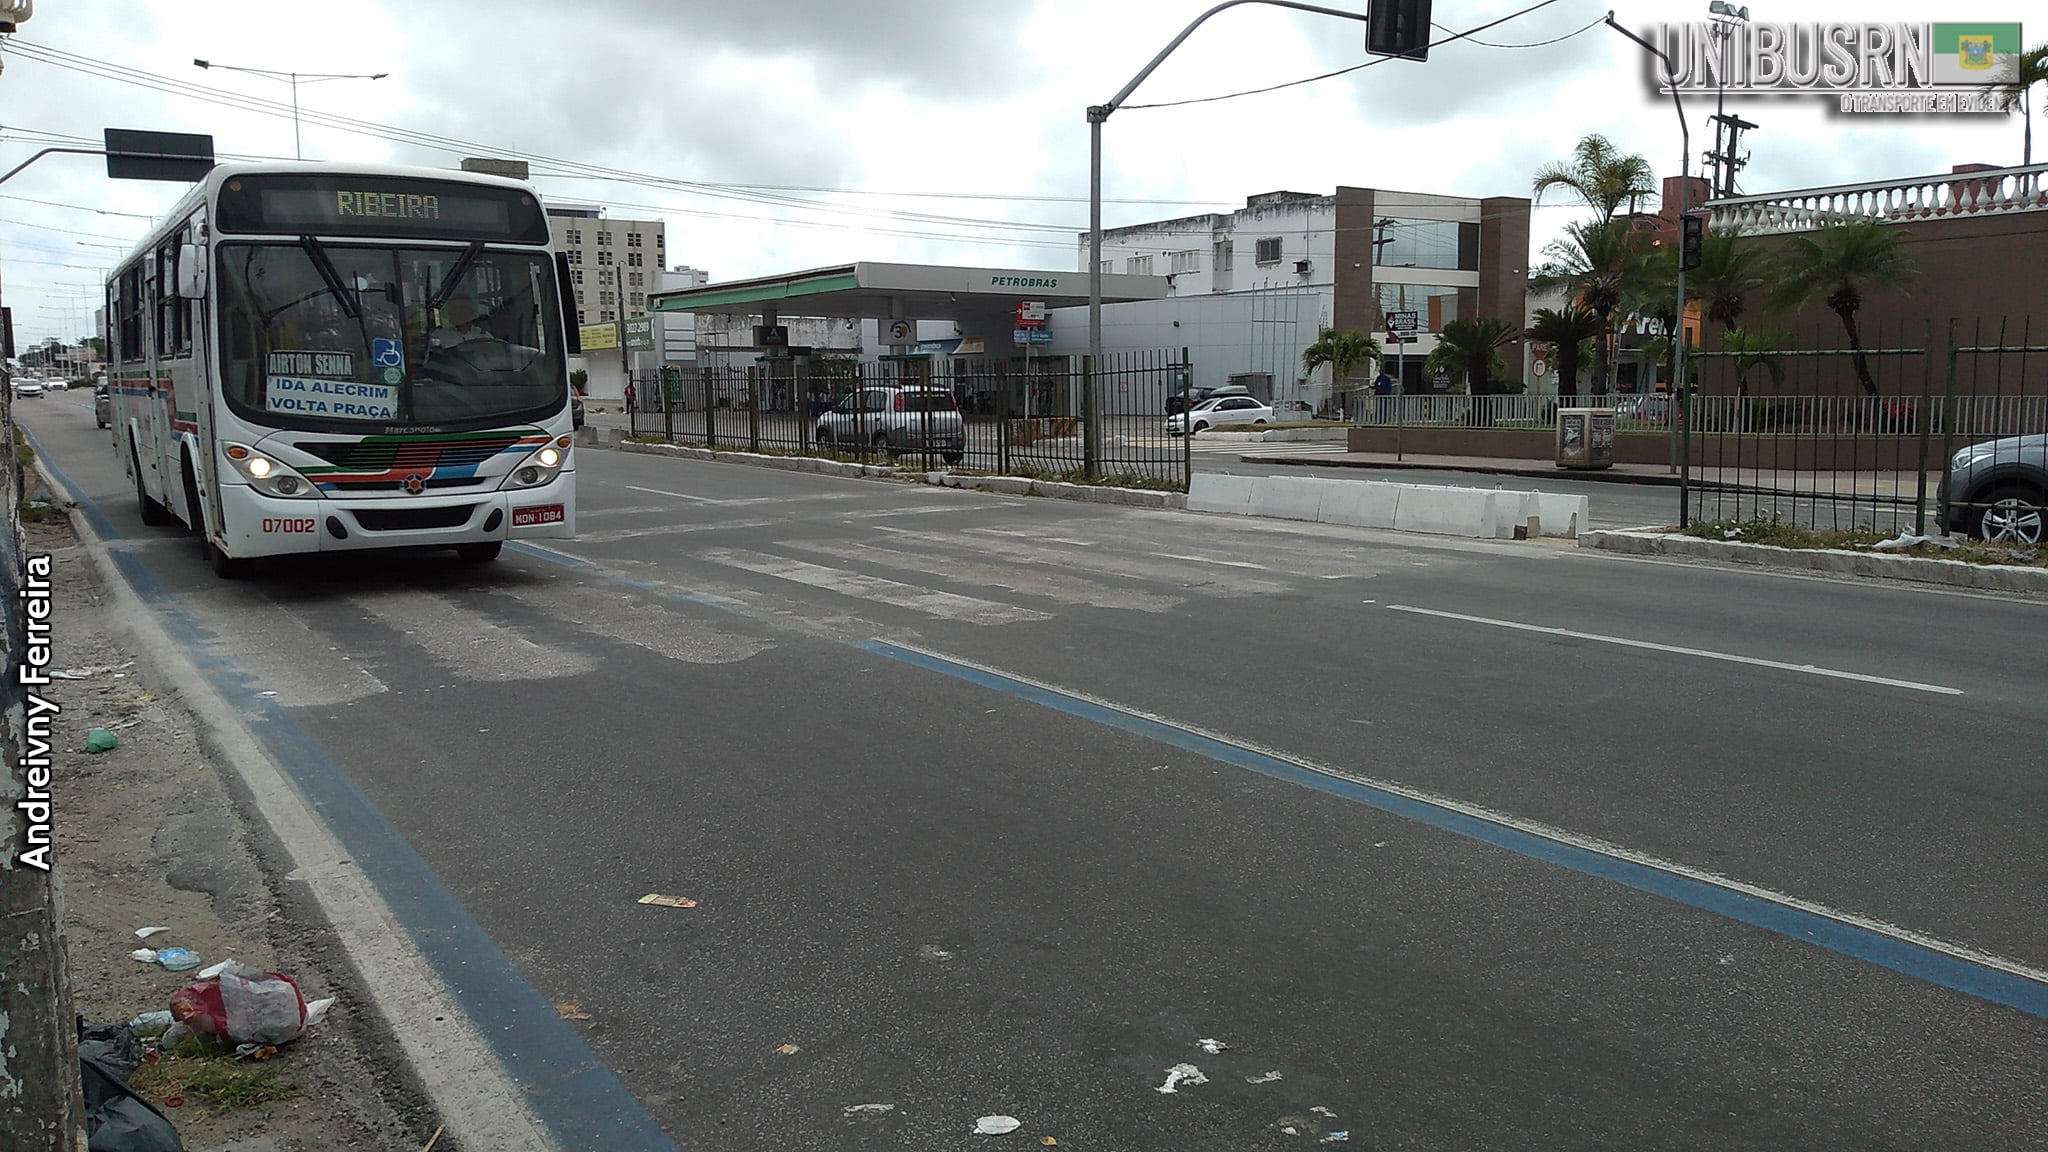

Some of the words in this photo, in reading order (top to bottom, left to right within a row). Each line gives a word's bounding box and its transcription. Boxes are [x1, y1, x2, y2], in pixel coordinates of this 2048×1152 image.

[337, 191, 439, 219] RIBEIRA
[991, 276, 1057, 288] PETROBRAS
[269, 353, 312, 375] AIRTON
[315, 354, 352, 376] SENNA
[276, 378, 306, 392] IDA
[311, 382, 388, 399] ALECRIM
[271, 397, 328, 413] VOLTA
[333, 402, 391, 418] PRAÇA
[262, 518, 316, 533] 07002
